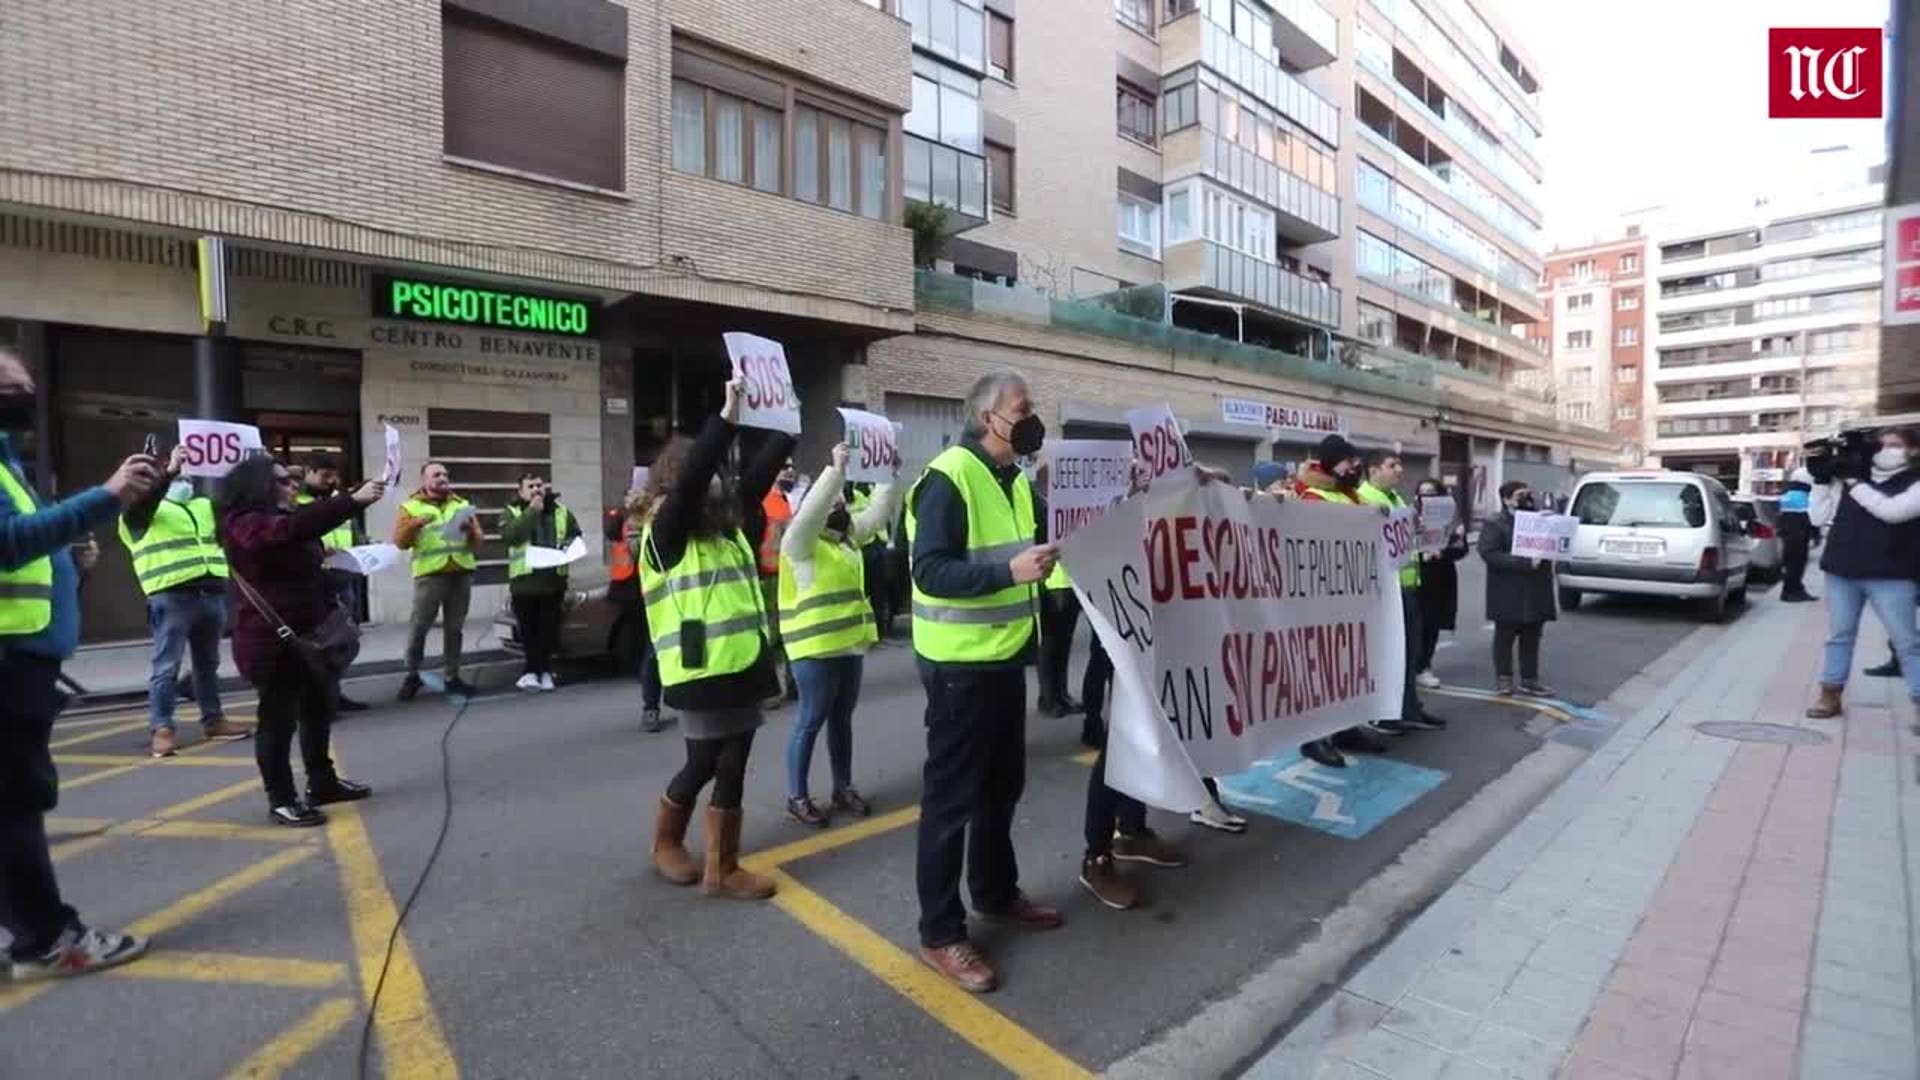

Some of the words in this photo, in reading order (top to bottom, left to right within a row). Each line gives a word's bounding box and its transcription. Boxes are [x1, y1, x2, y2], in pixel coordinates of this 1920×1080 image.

[393, 280, 588, 334] PSICOTECNICO
[371, 325, 462, 350] CENTRO
[480, 336, 598, 361] BENAVENTE
[741, 355, 785, 410] SOS
[185, 433, 240, 466] SOS
[860, 426, 893, 469] SOS
[1139, 416, 1179, 478] SOS
[1052, 456, 1081, 490] JEFE
[1082, 456, 1098, 489] DE
[1144, 515, 1282, 603] OESCUELAS
[1286, 538, 1307, 598] DE
